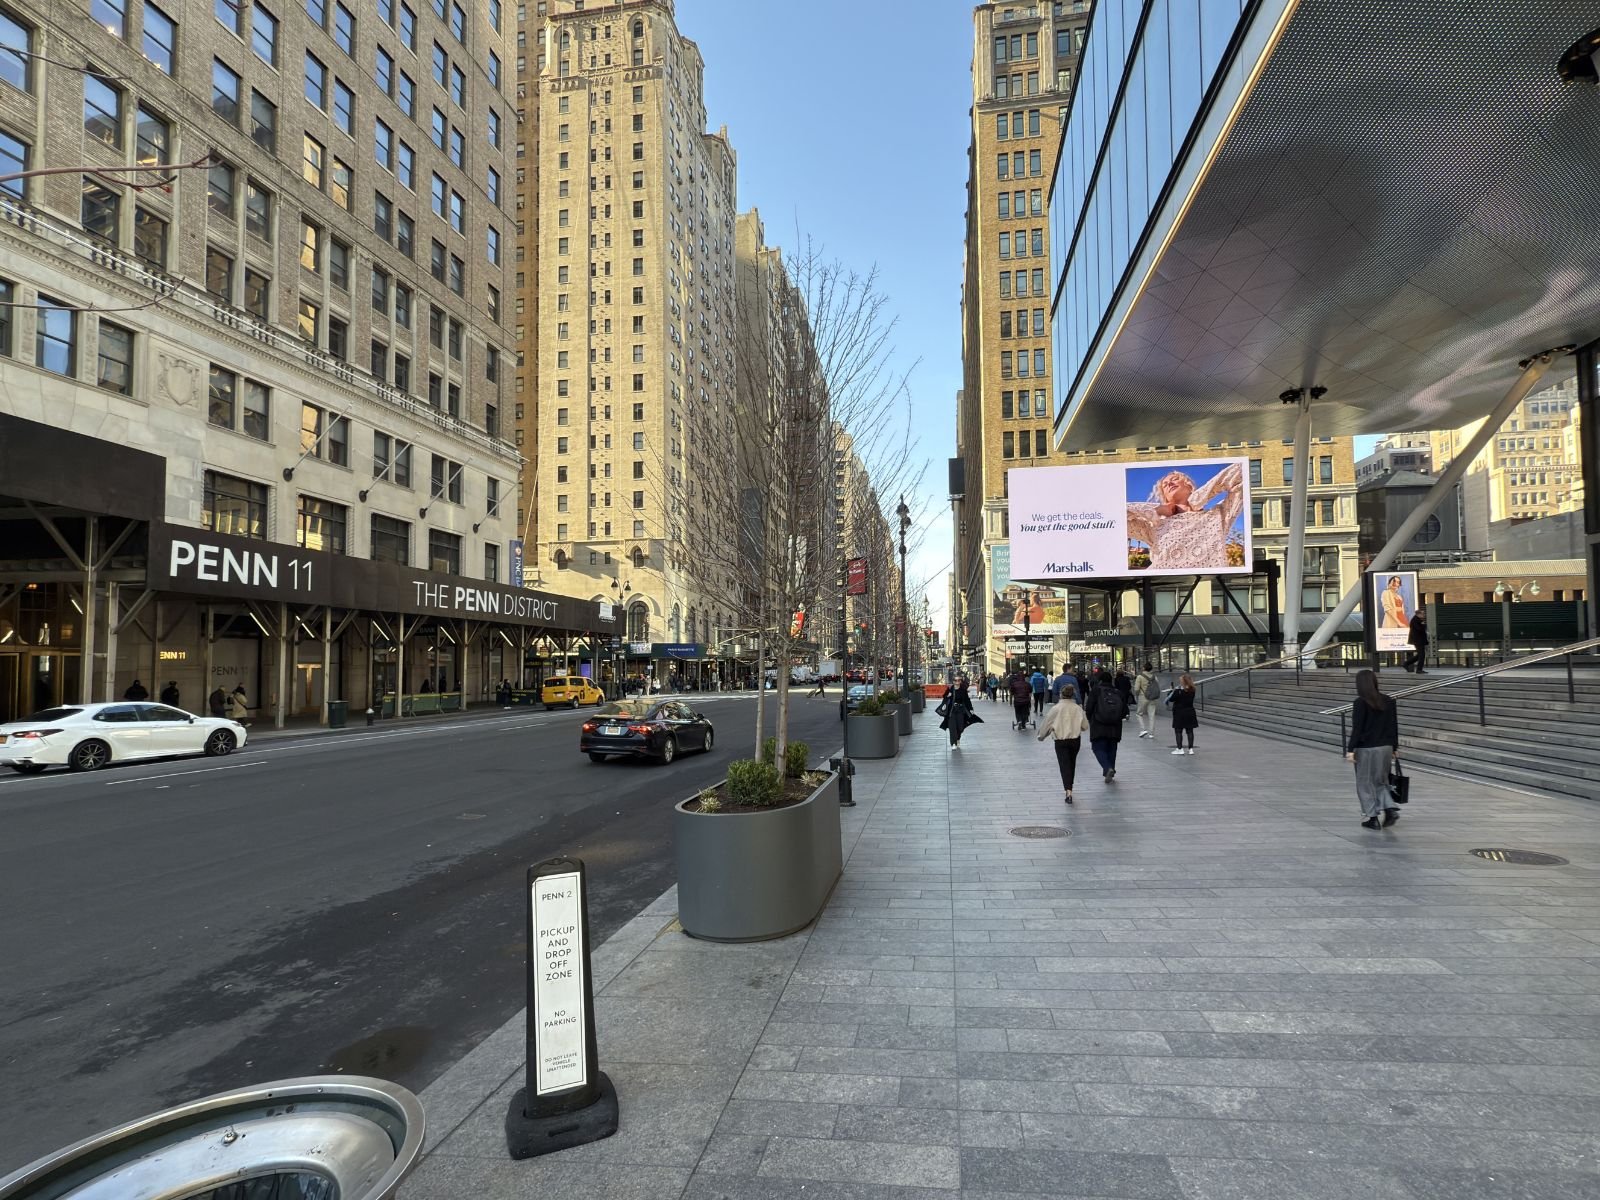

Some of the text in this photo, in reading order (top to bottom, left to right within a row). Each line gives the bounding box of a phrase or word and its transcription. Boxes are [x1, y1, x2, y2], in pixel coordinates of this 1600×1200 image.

[1031, 513, 1045, 522] We
[1046, 513, 1060, 523] get
[1063, 512, 1078, 521] the
[1019, 523, 1037, 532] You
[1037, 523, 1052, 533] get
[1052, 522, 1067, 531] the
[1068, 521, 1091, 532] good
[169, 539, 312, 592] PENN 11
[1042, 561, 1095, 574] Marshalls
[412, 580, 559, 622] THE PENN DISTRICT
[1094, 629, 1120, 637] STATION
[1007, 643, 1052, 652] smasburger
[160, 651, 186, 660] ENN 11
[541, 890, 573, 901] PENN 2
[540, 925, 575, 938] PICKUP
[547, 938, 569, 948] AND
[545, 948, 572, 959] DROP
[549, 960, 568, 970] OFF
[545, 969, 573, 981] ZONE
[554, 1009, 566, 1018] NO
[544, 1016, 577, 1028] PARKING
